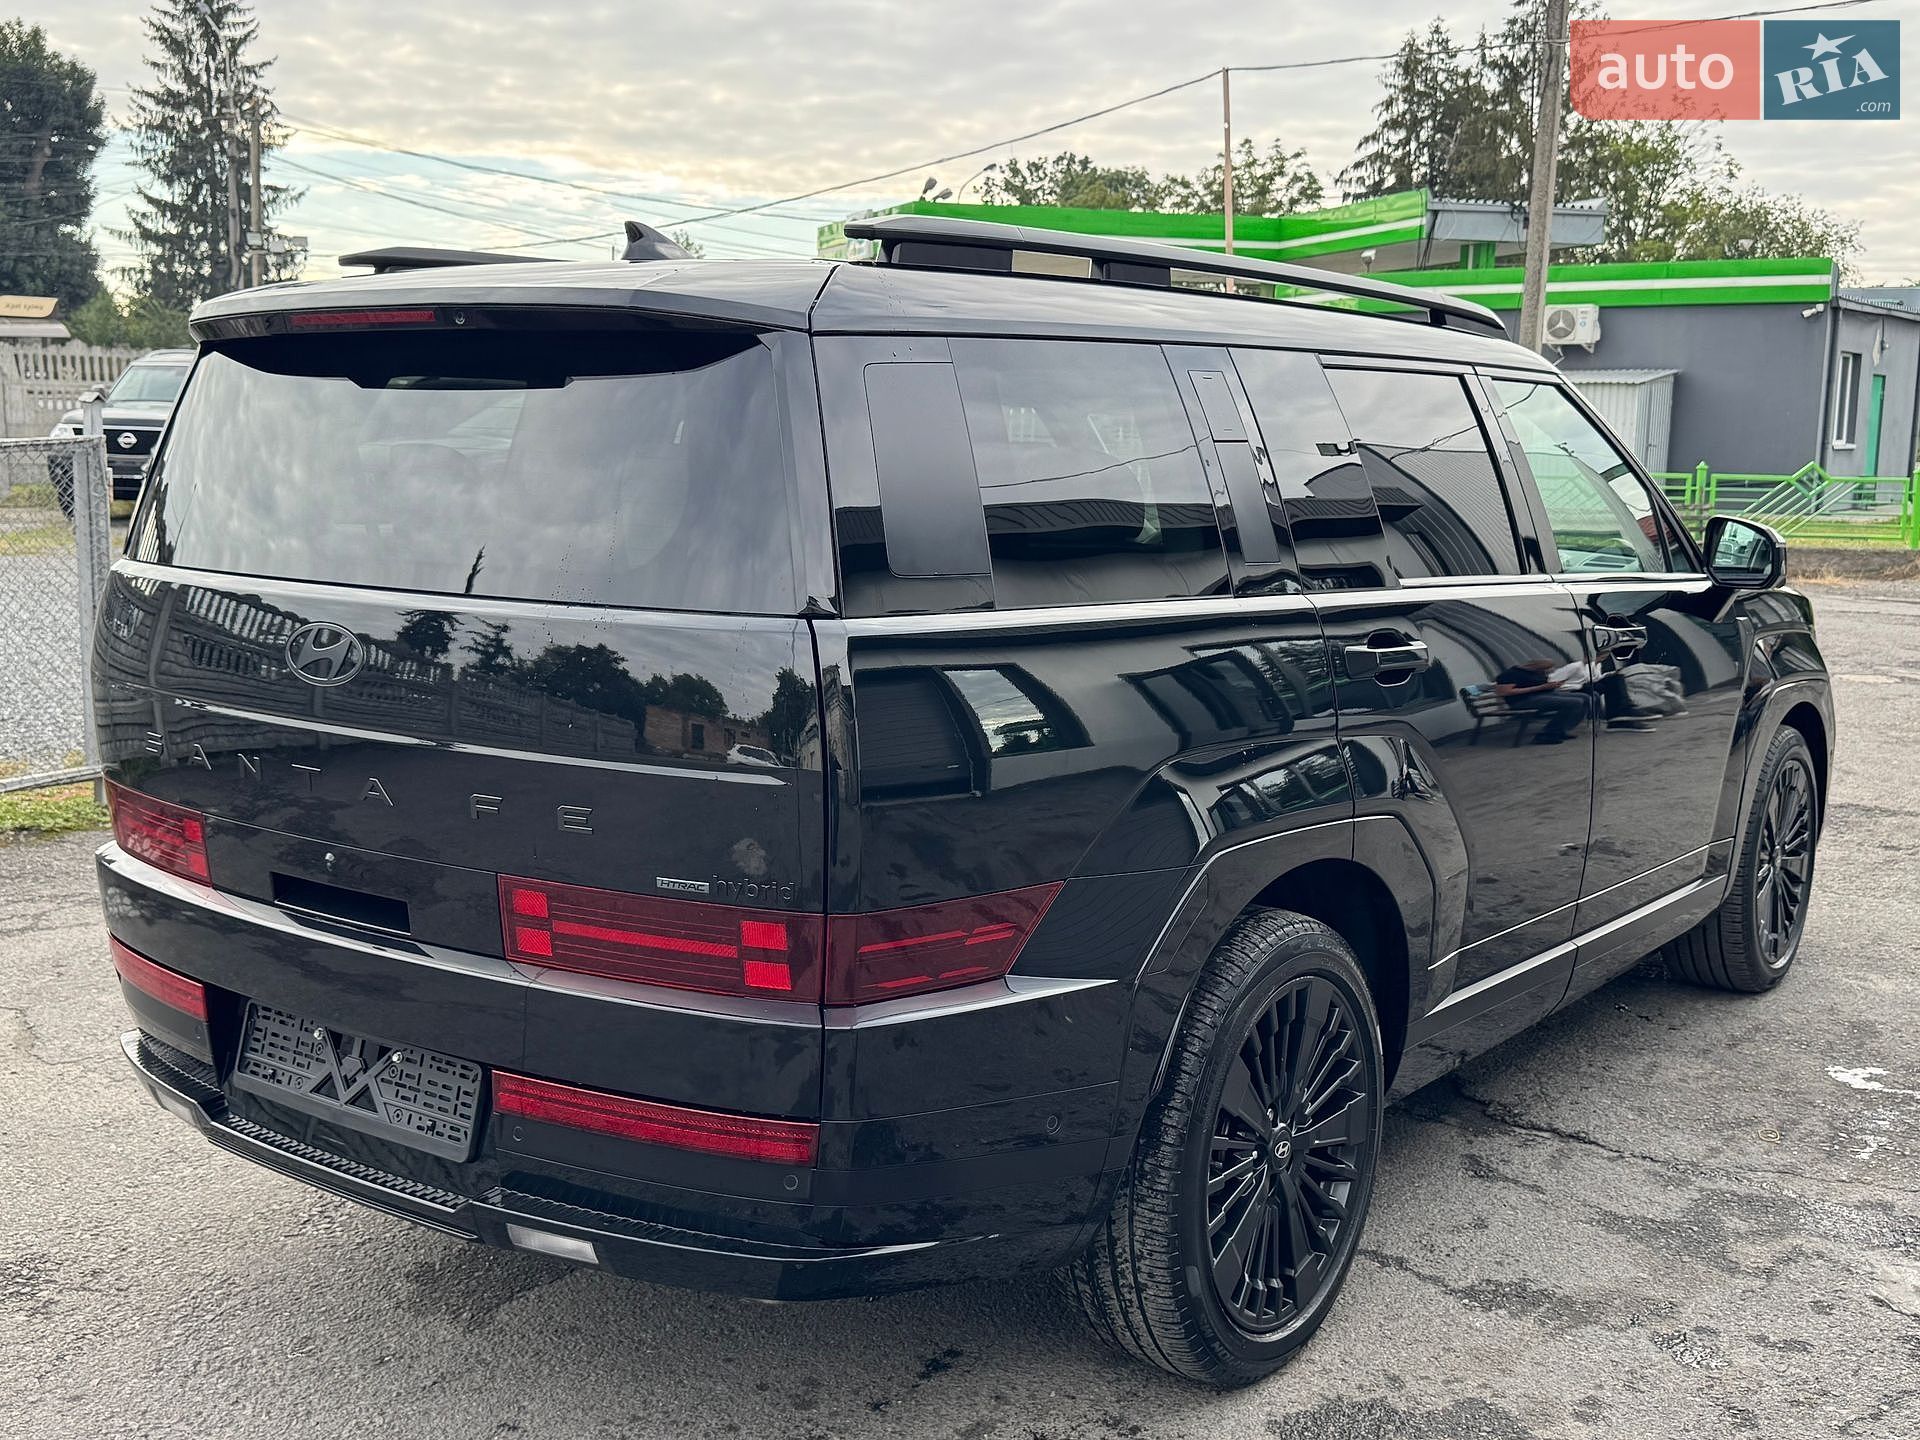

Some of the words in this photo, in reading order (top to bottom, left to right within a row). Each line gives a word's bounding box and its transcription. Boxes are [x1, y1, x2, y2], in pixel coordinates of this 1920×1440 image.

[145, 731, 395, 807] SANTA
[470, 793, 594, 836] FE
[657, 877, 709, 894] HTRAC
[712, 874, 796, 902] hybrid
